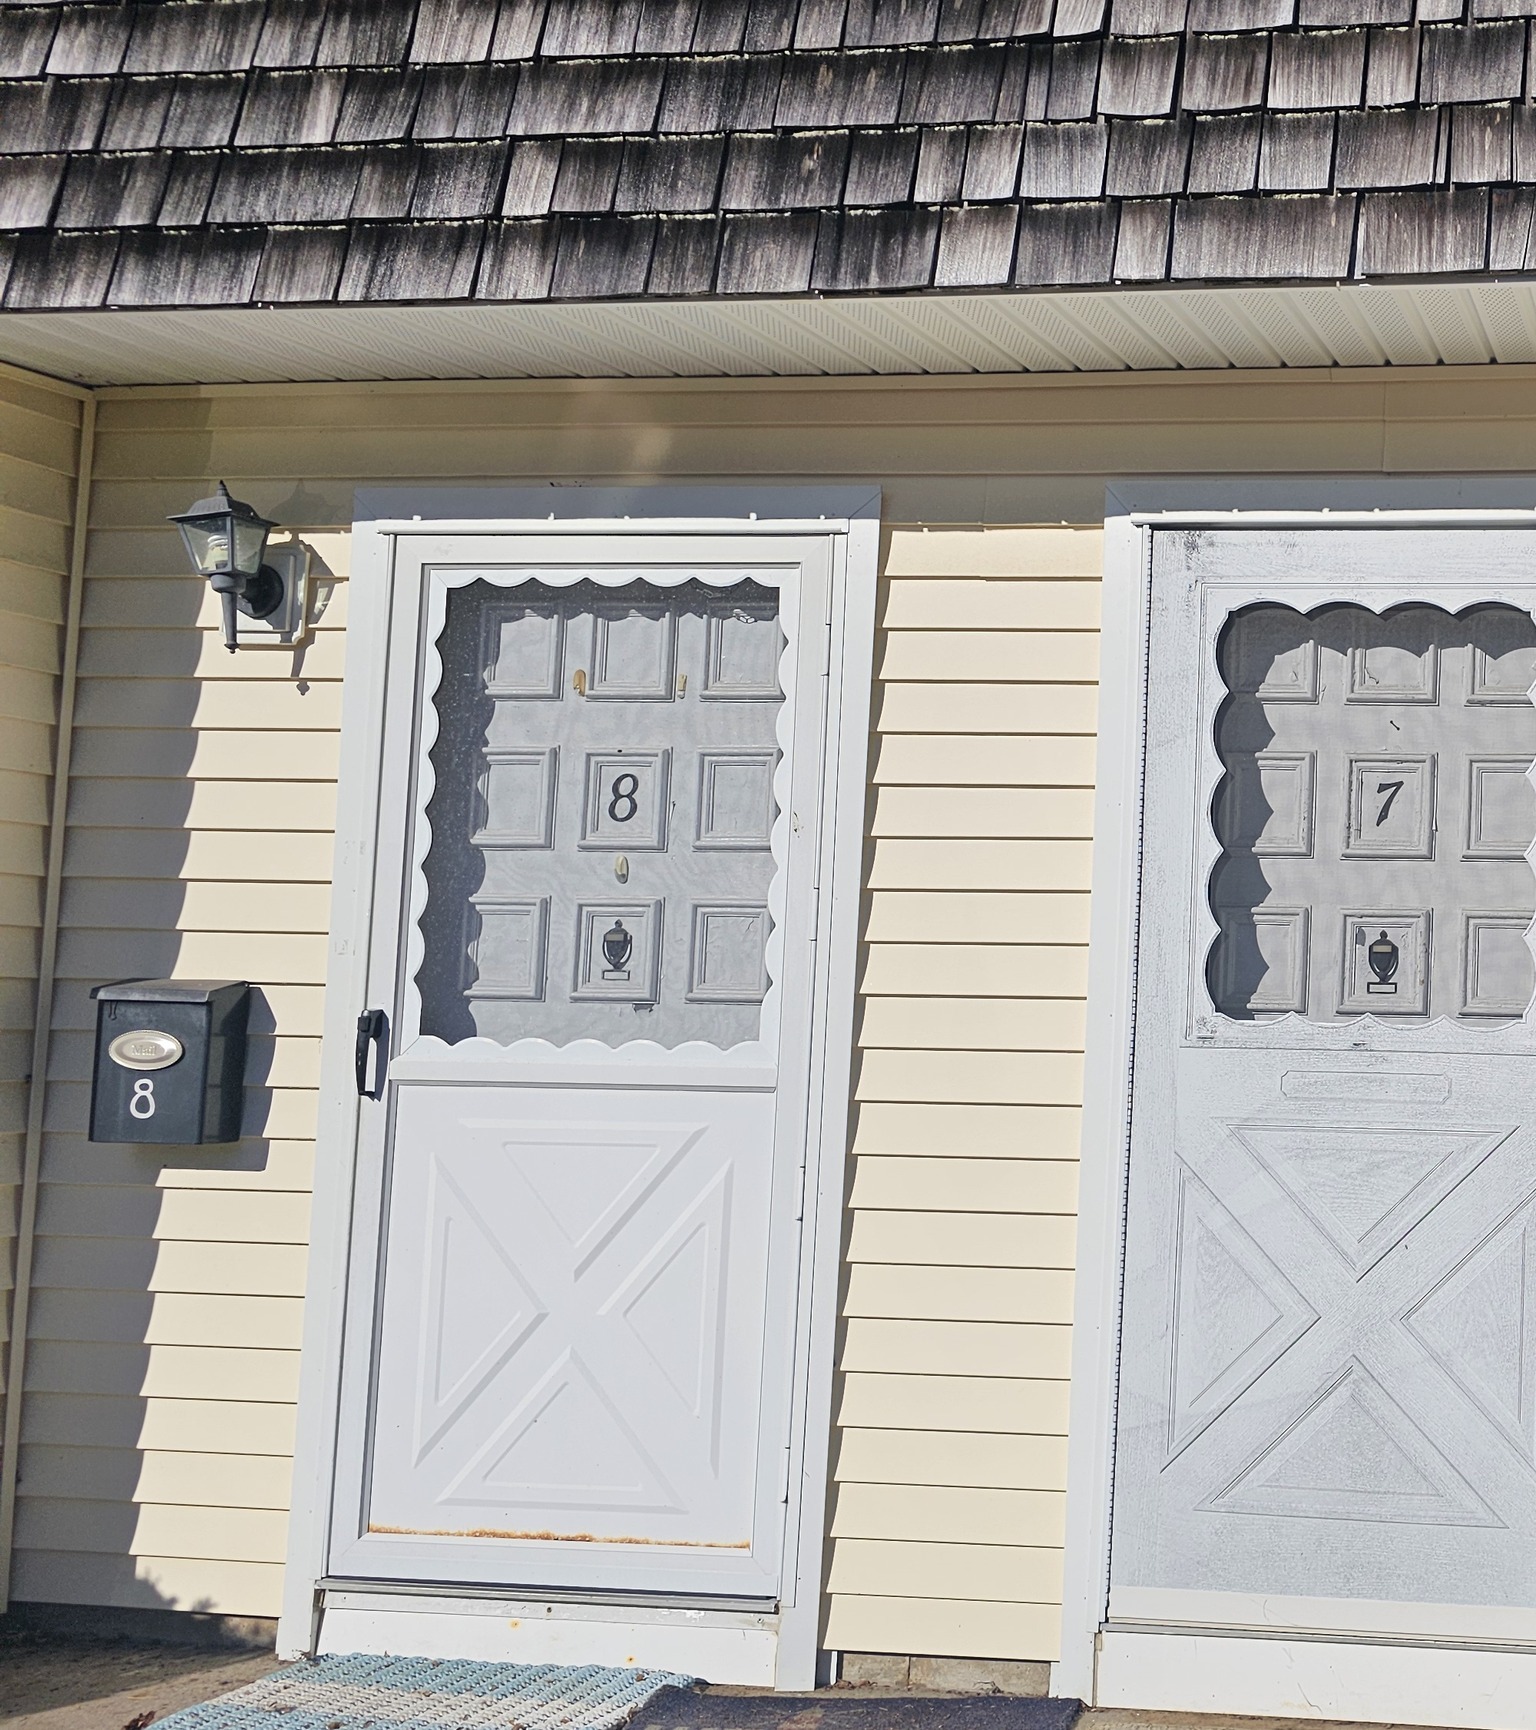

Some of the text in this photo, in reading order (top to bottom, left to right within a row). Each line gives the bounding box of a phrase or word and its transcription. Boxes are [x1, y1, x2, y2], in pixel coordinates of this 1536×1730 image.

[608, 773, 639, 822] 8
[1376, 780, 1404, 827] 7
[131, 1044, 157, 1056] Mail
[129, 1078, 155, 1119] 8
